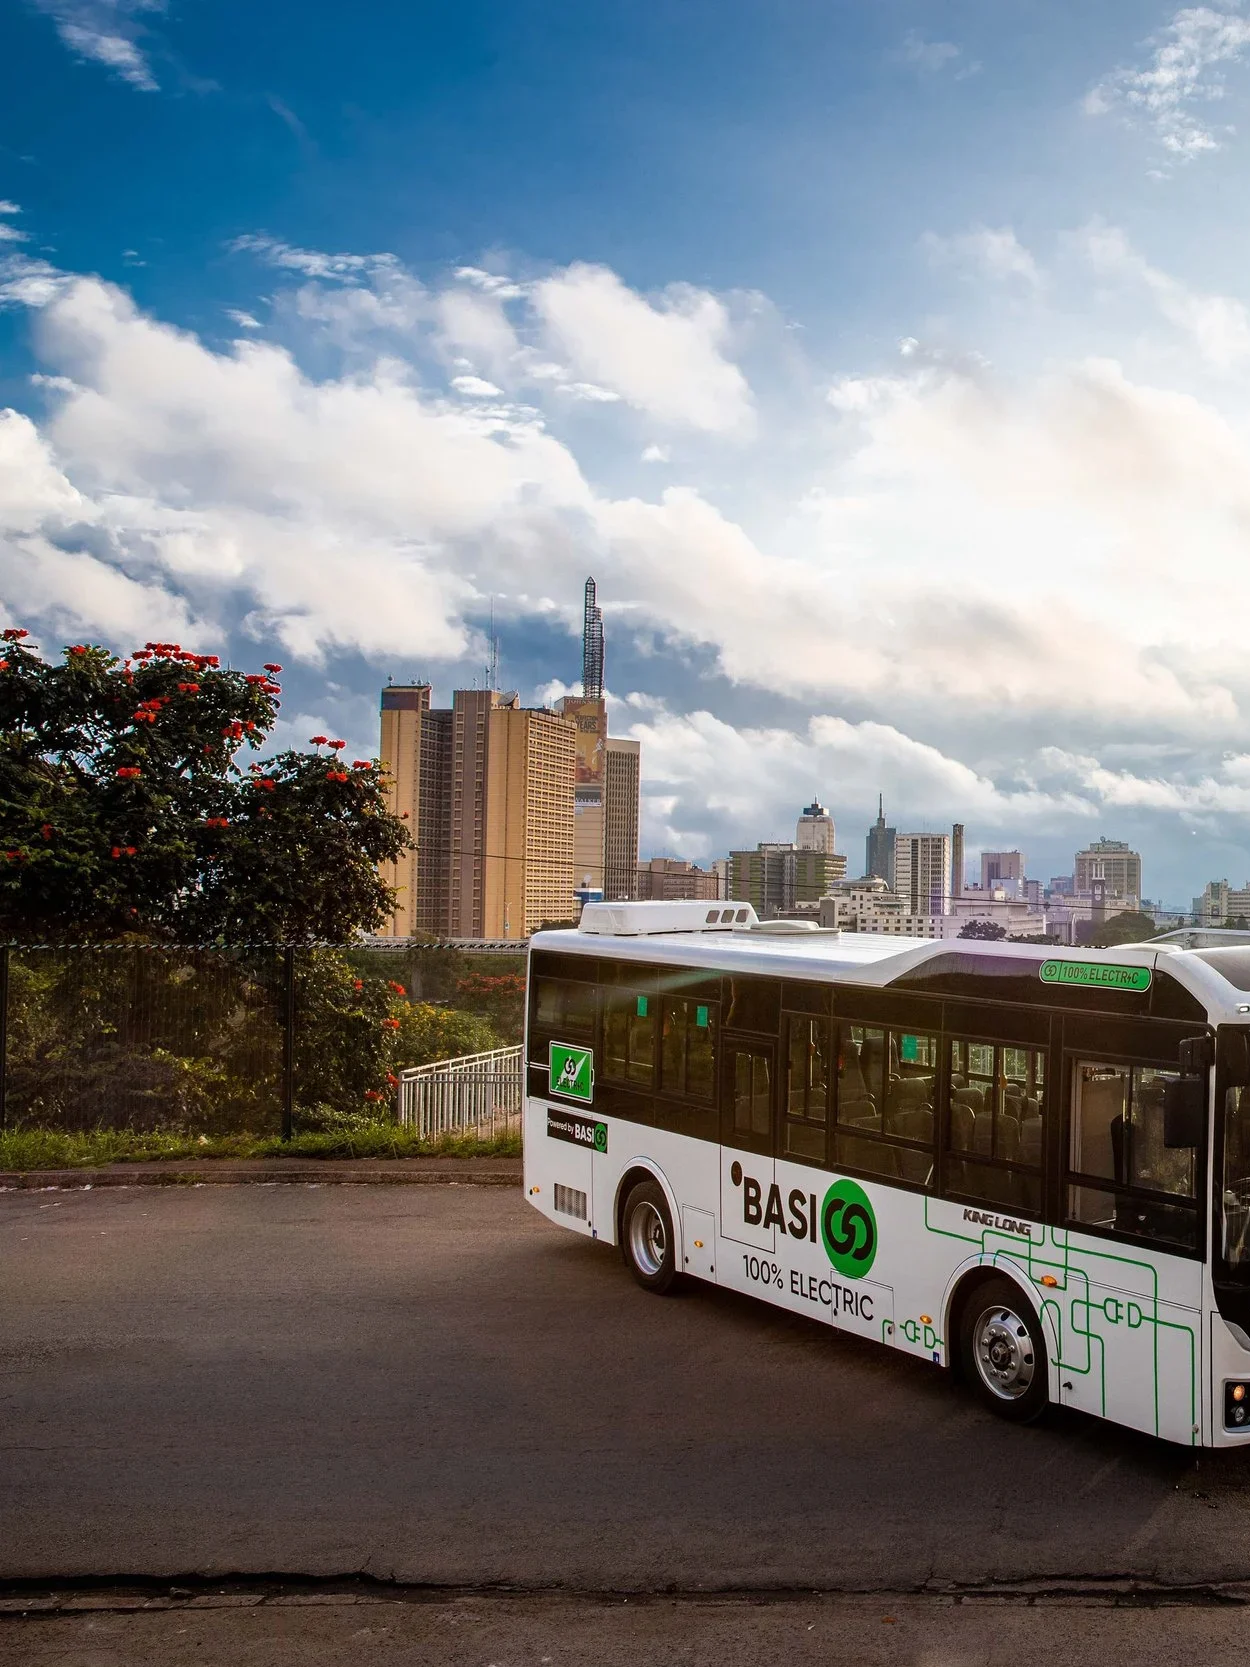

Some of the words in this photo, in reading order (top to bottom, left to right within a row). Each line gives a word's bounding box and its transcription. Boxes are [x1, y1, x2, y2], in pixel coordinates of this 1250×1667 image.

[1063, 966, 1088, 980] 100%
[547, 1118, 568, 1131] Powered
[568, 1122, 574, 1135] by
[963, 1208, 994, 1227] KING
[995, 1216, 1032, 1236] LONG
[743, 1255, 783, 1289] 100%
[790, 1269, 874, 1321] ELECTRIC
